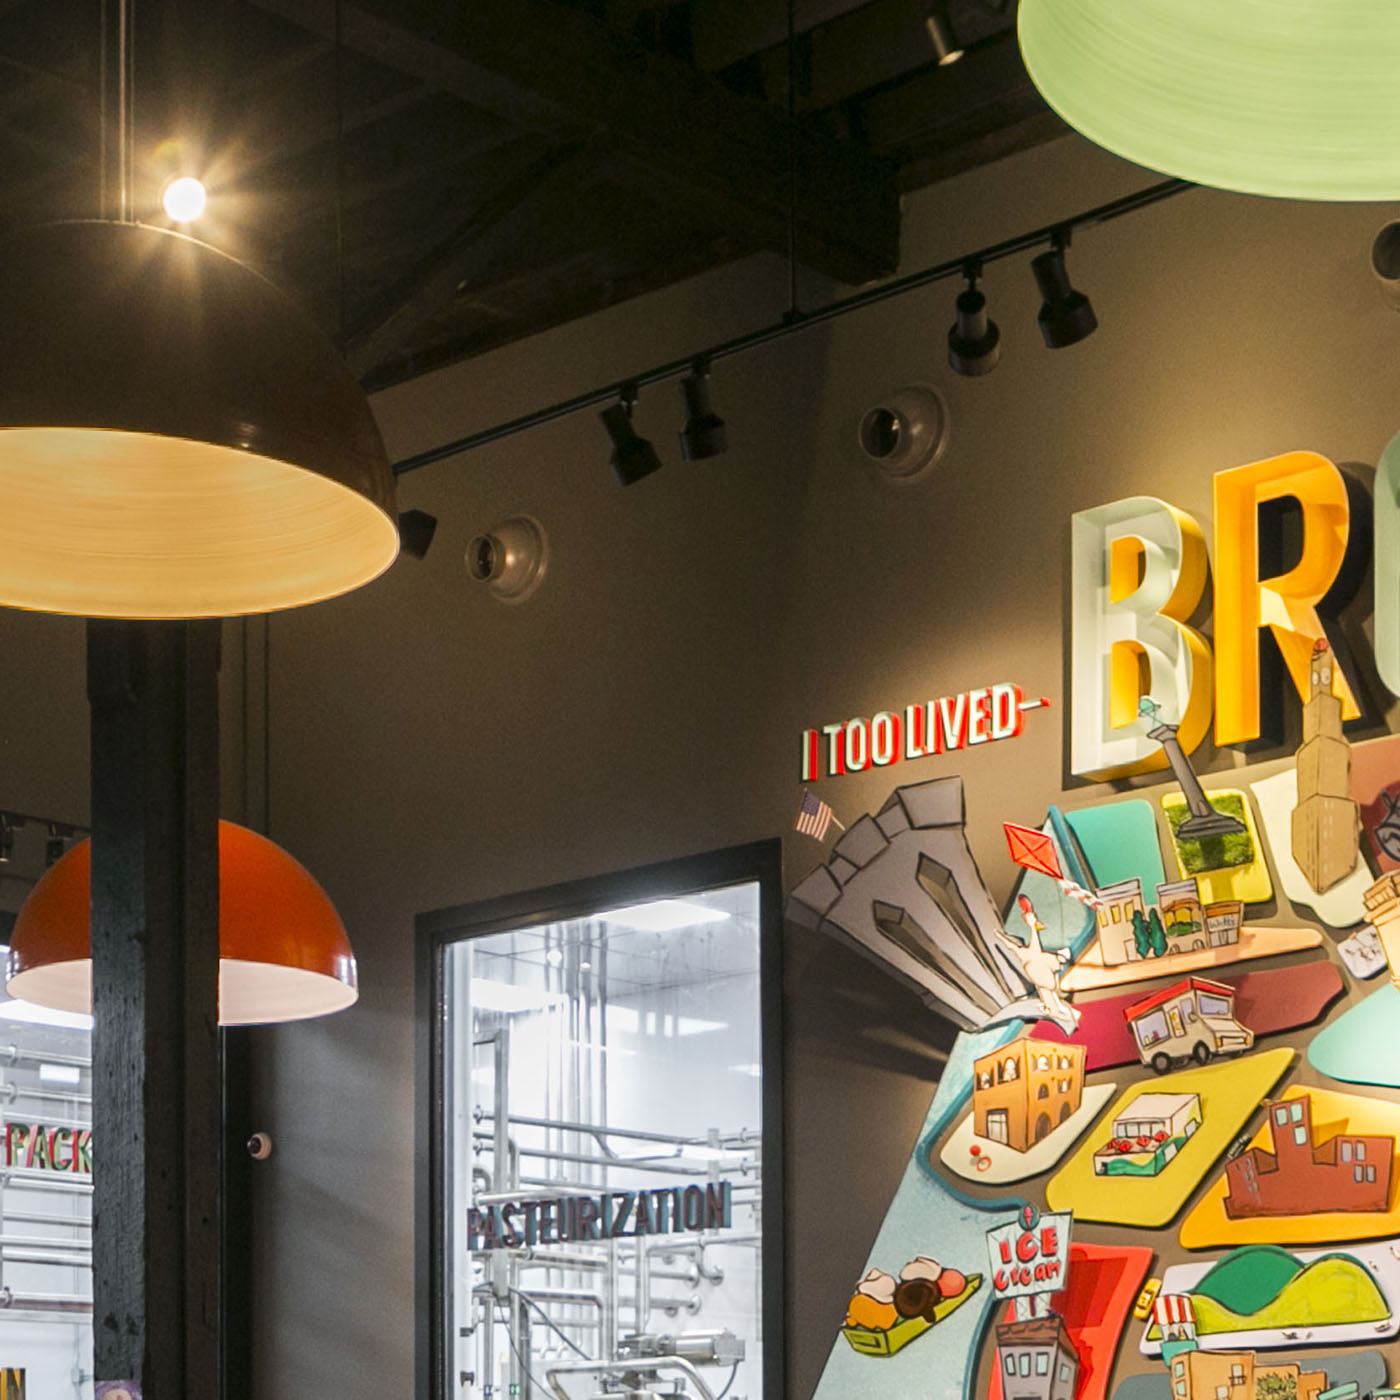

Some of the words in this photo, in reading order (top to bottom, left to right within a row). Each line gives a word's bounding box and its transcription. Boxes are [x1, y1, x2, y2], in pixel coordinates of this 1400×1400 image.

[802, 728, 818, 781] I
[823, 710, 902, 776] TOO
[467, 1180, 732, 1251] PASTEURIZATION
[999, 1226, 1059, 1264] ICE
